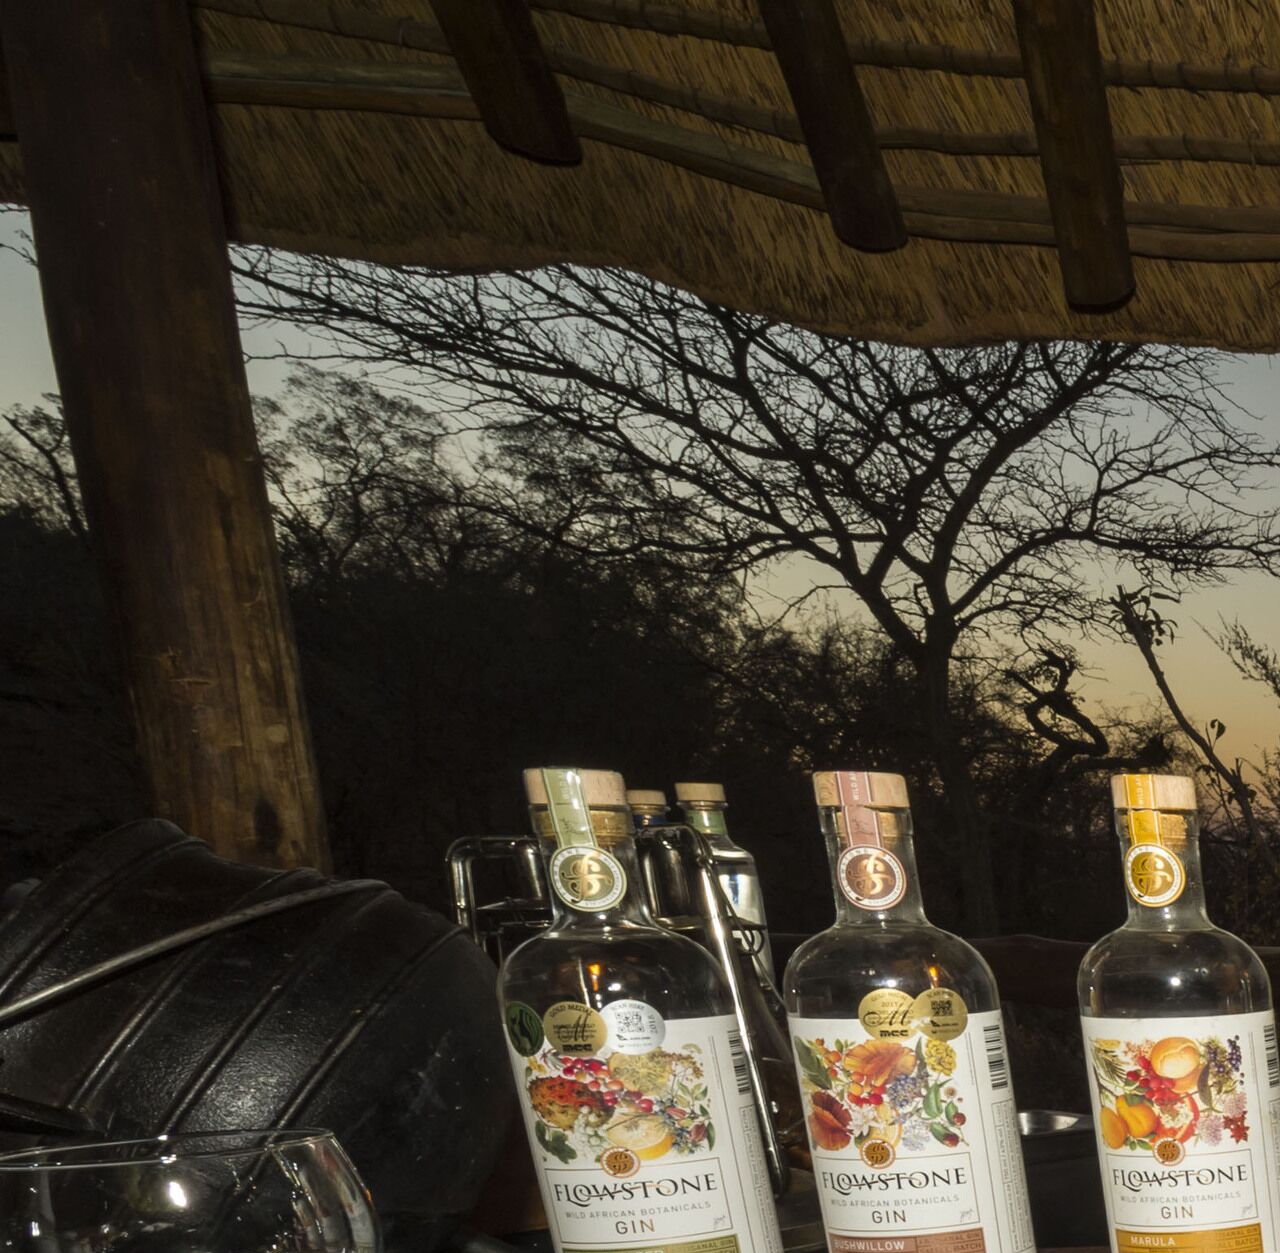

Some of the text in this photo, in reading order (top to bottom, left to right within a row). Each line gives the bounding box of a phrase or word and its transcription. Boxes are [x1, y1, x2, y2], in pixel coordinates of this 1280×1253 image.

[822, 1166, 968, 1196] FLOWSTONE
[1113, 1164, 1248, 1192] FLOWSTONE
[553, 1173, 719, 1208] FLOWSTONE
[1182, 1190, 1242, 1204] BOTANICALS
[850, 1199, 891, 1208] AFRICAN
[894, 1195, 961, 1208] BOTANICALS
[589, 1208, 636, 1219] AFRICAN
[640, 1201, 712, 1217] BOTANICALS
[871, 1209, 907, 1225] GIN
[1161, 1205, 1195, 1220] GIN
[615, 1218, 656, 1235] GIN
[1130, 1235, 1177, 1247] MARULA
